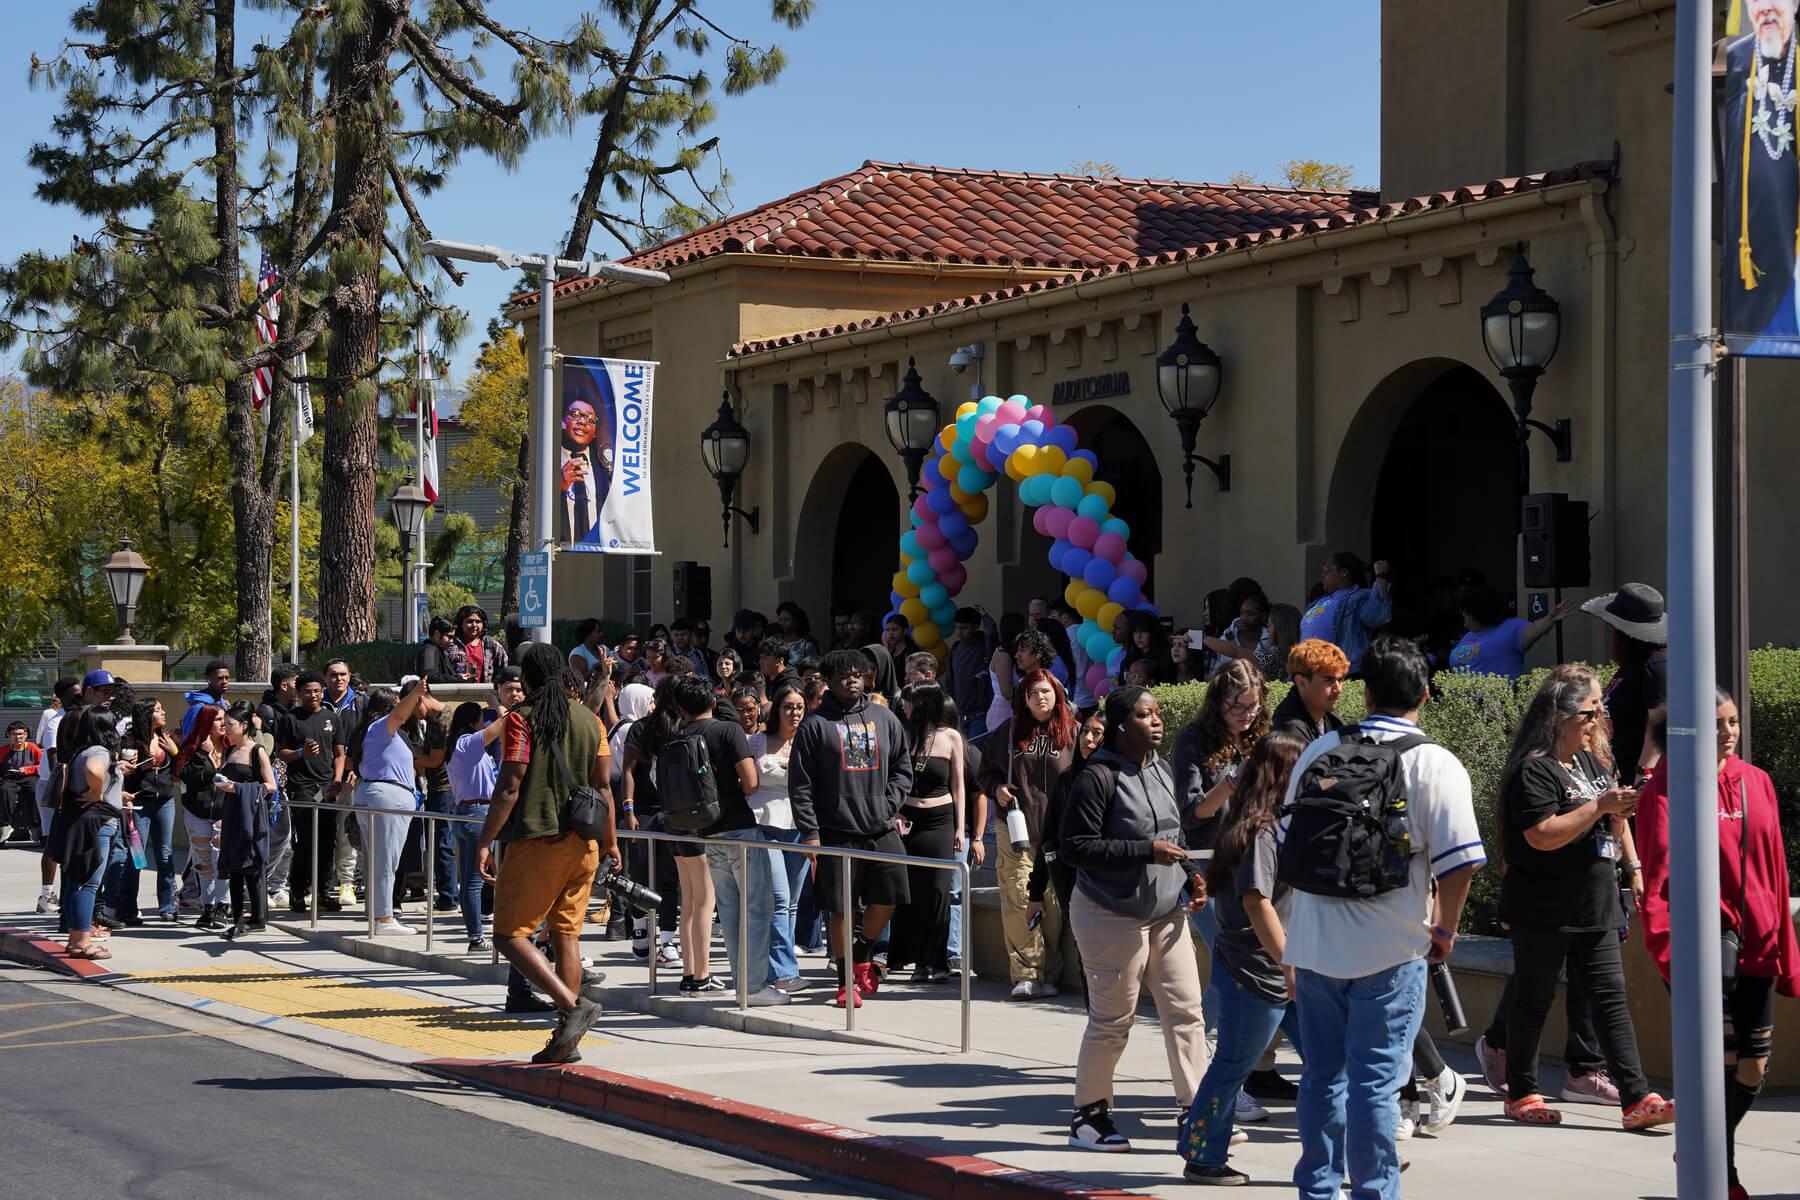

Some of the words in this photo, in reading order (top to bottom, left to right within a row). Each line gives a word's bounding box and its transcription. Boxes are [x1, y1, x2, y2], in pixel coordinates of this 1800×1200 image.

[1053, 370, 1130, 404] AUDITORIUM
[622, 364, 643, 496] WELCOME
[521, 616, 528, 625] NO
[528, 616, 544, 625] PARKING
